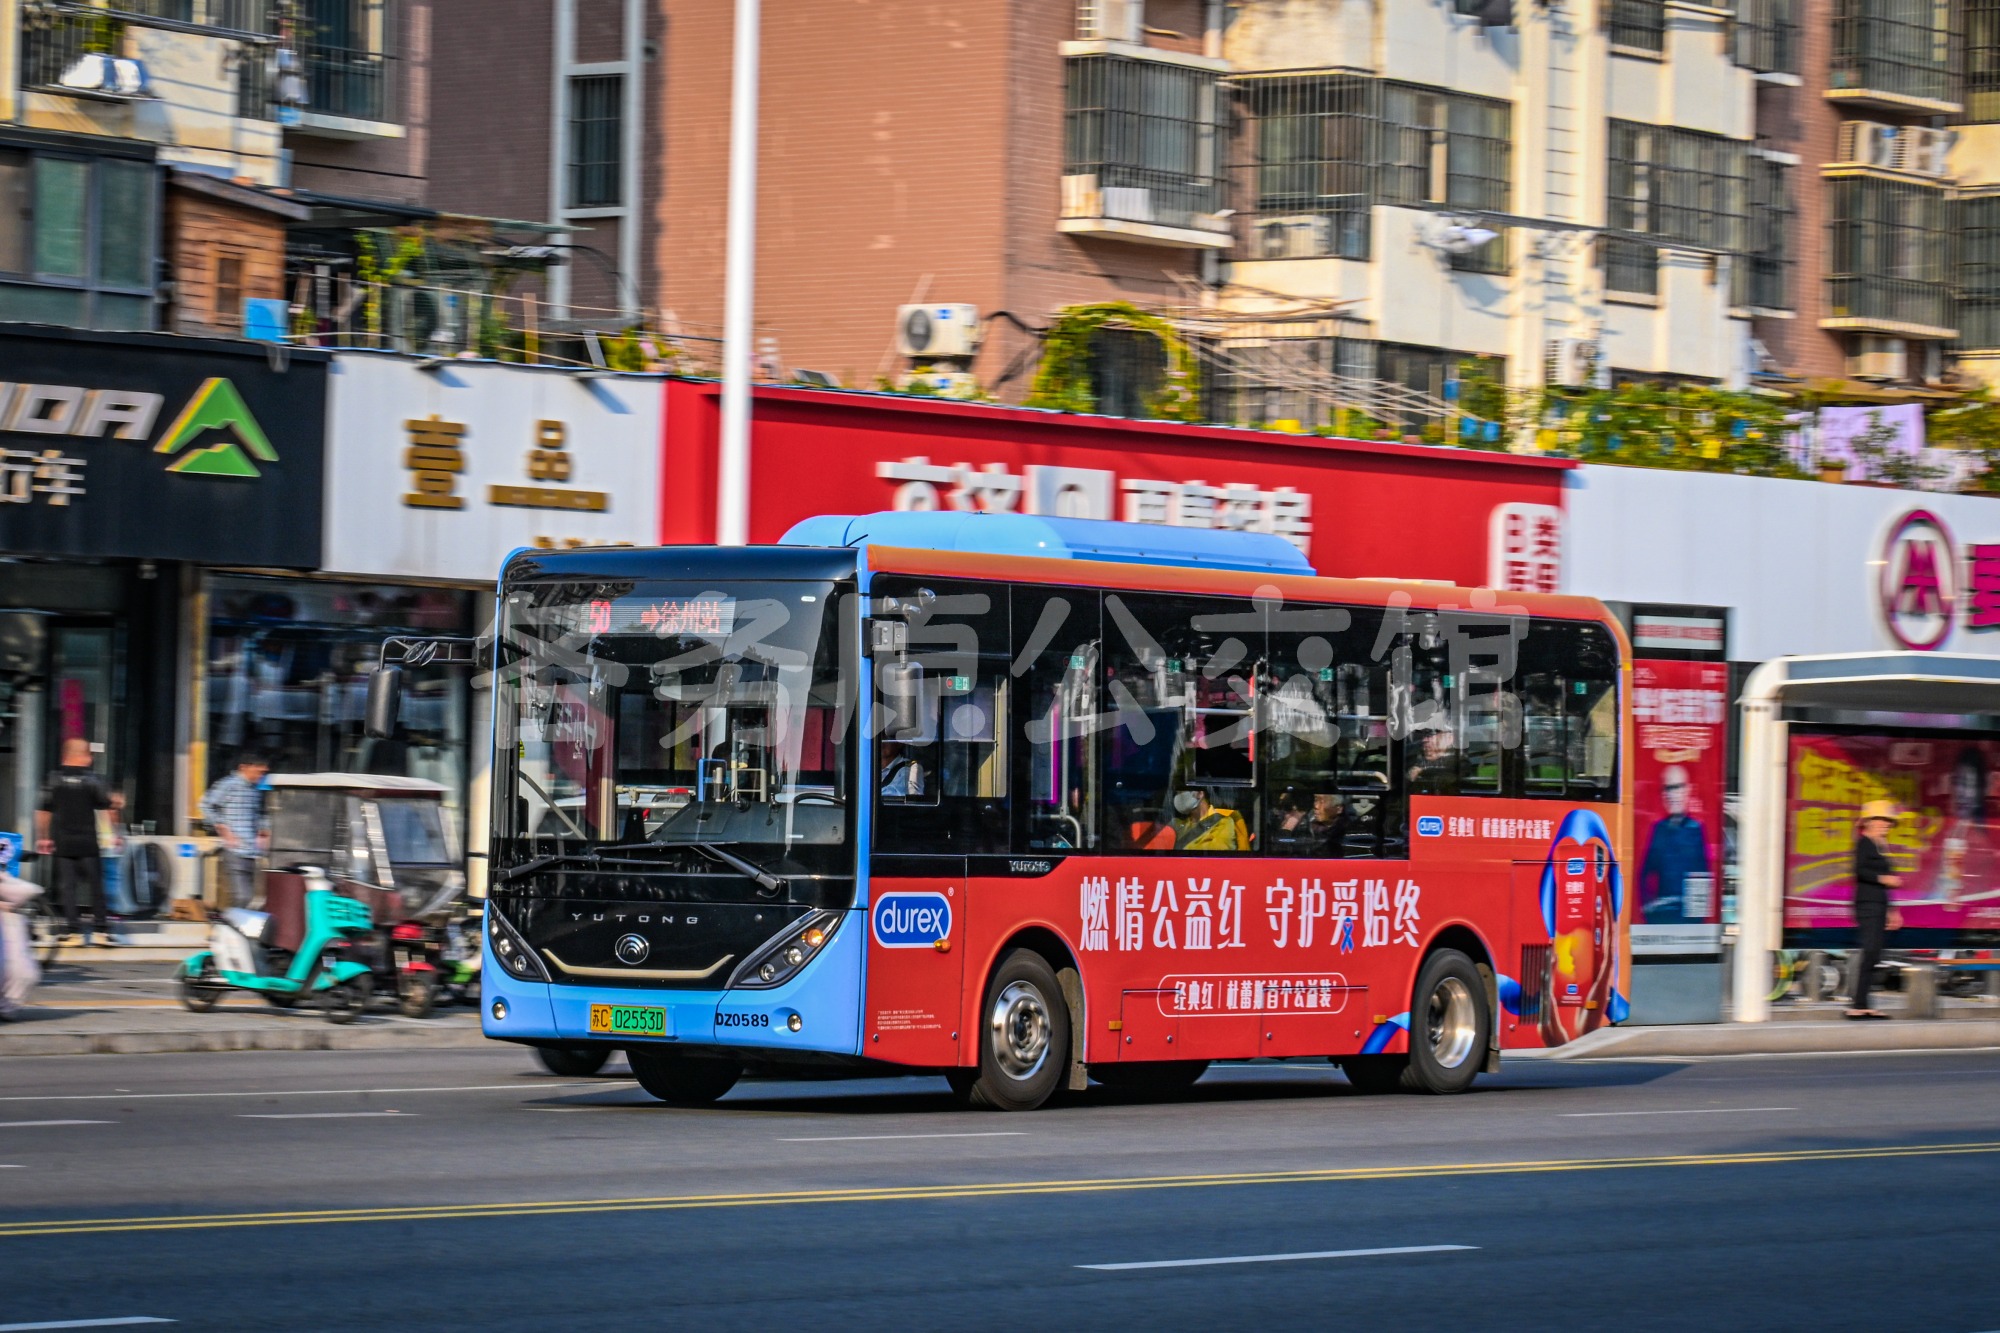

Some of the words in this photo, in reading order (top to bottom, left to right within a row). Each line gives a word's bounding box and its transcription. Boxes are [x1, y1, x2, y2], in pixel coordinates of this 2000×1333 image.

[589, 601, 611, 633] 50
[660, 601, 722, 634] 徐州站
[1009, 860, 1051, 873] YUTONG
[572, 913, 698, 924] YUTONG
[880, 900, 945, 938] durex
[1079, 876, 1247, 952] 燃情公益红
[1265, 878, 1422, 950] 守护爱始终
[1173, 980, 1214, 1010] 经典红
[715, 1012, 769, 1027] DZ0589
